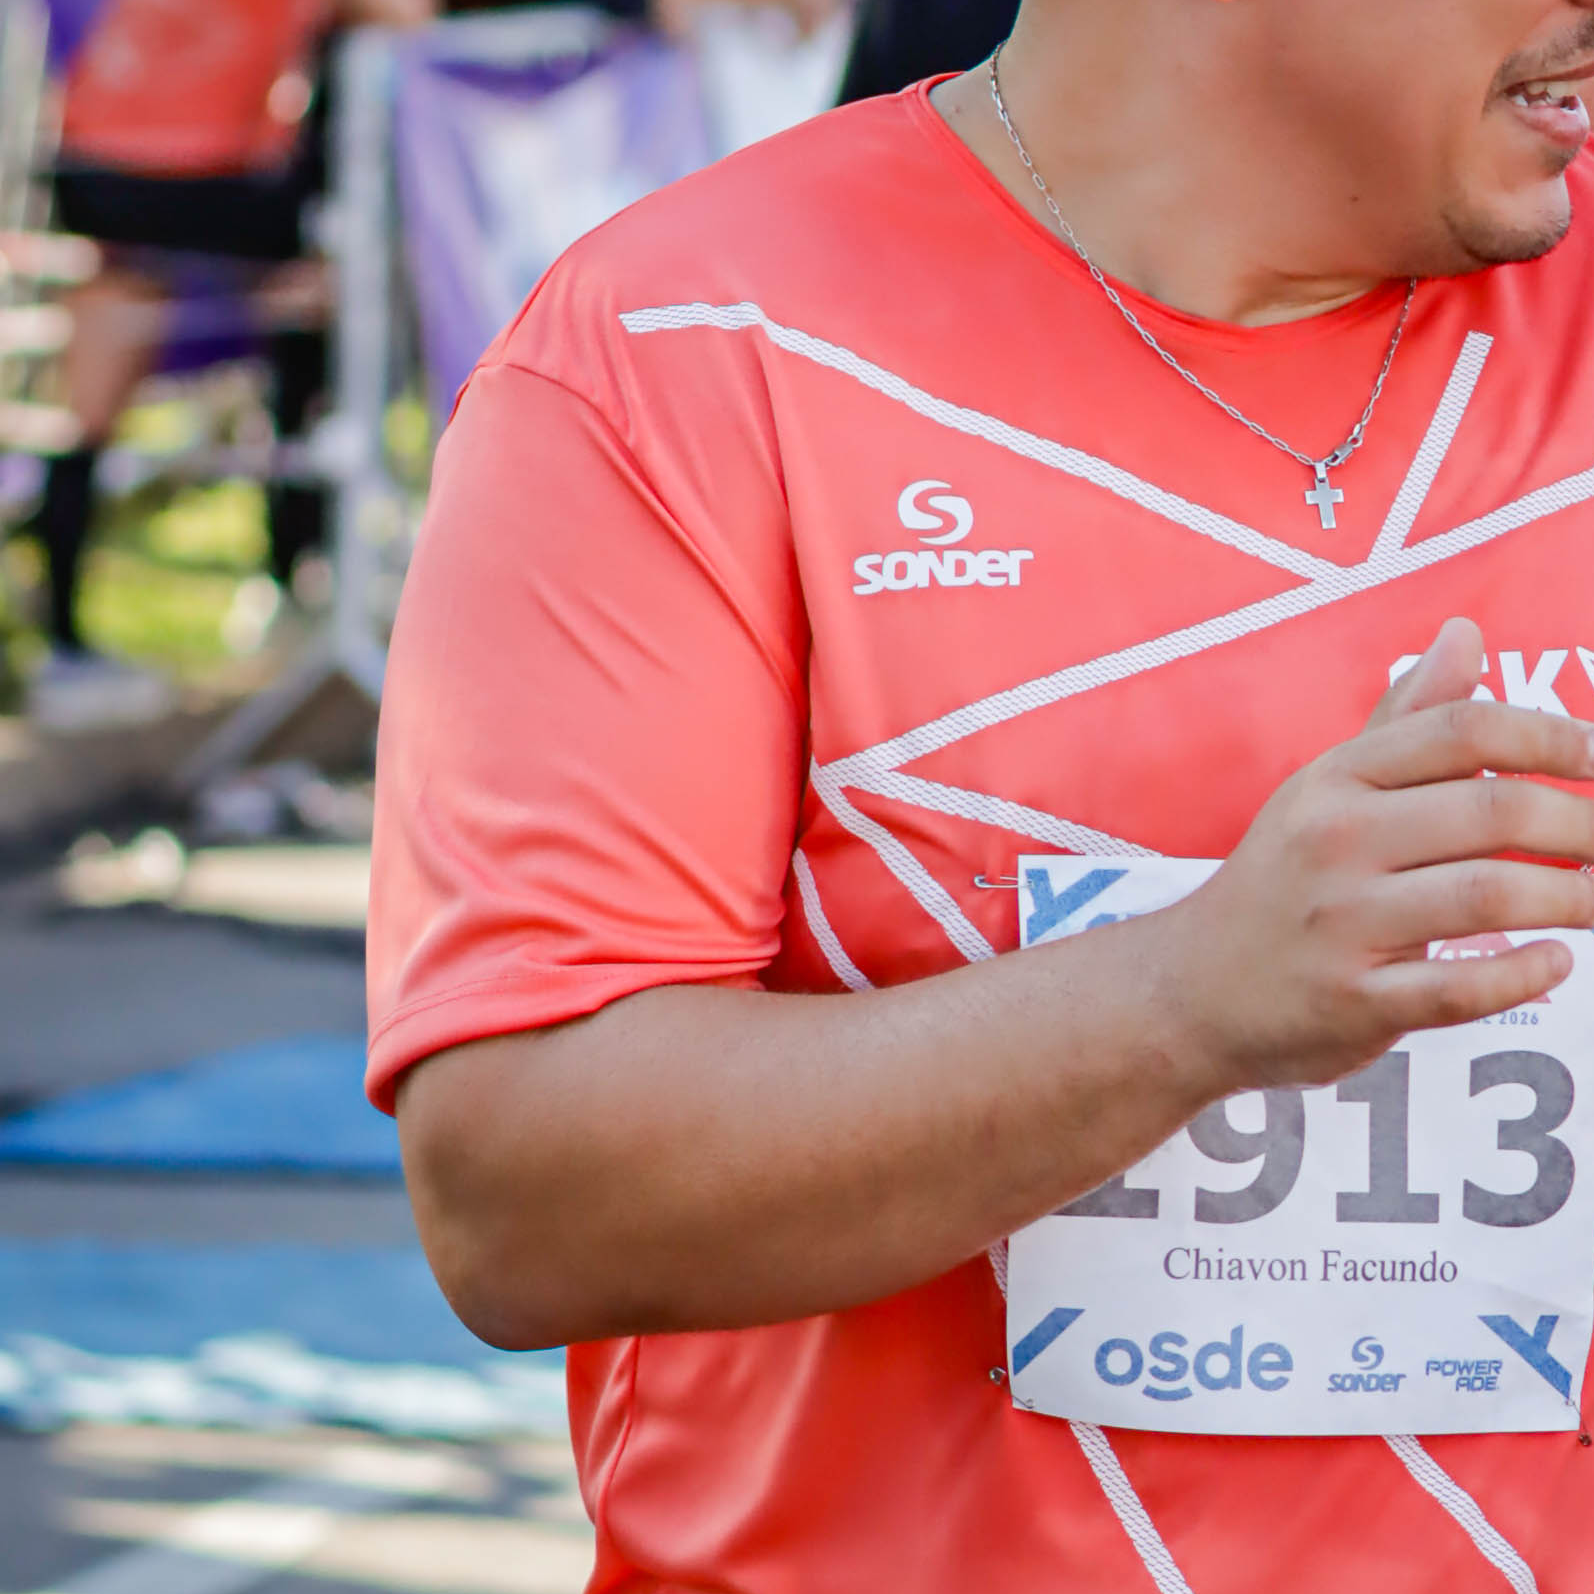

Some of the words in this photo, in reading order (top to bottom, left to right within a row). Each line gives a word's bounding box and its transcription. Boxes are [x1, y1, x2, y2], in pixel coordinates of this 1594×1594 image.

[1162, 1246, 1308, 1283] Chiavon
[1320, 1249, 1459, 1283] Facundo
[1094, 1324, 1294, 1392] osde
[1425, 1359, 1503, 1377] POWER
